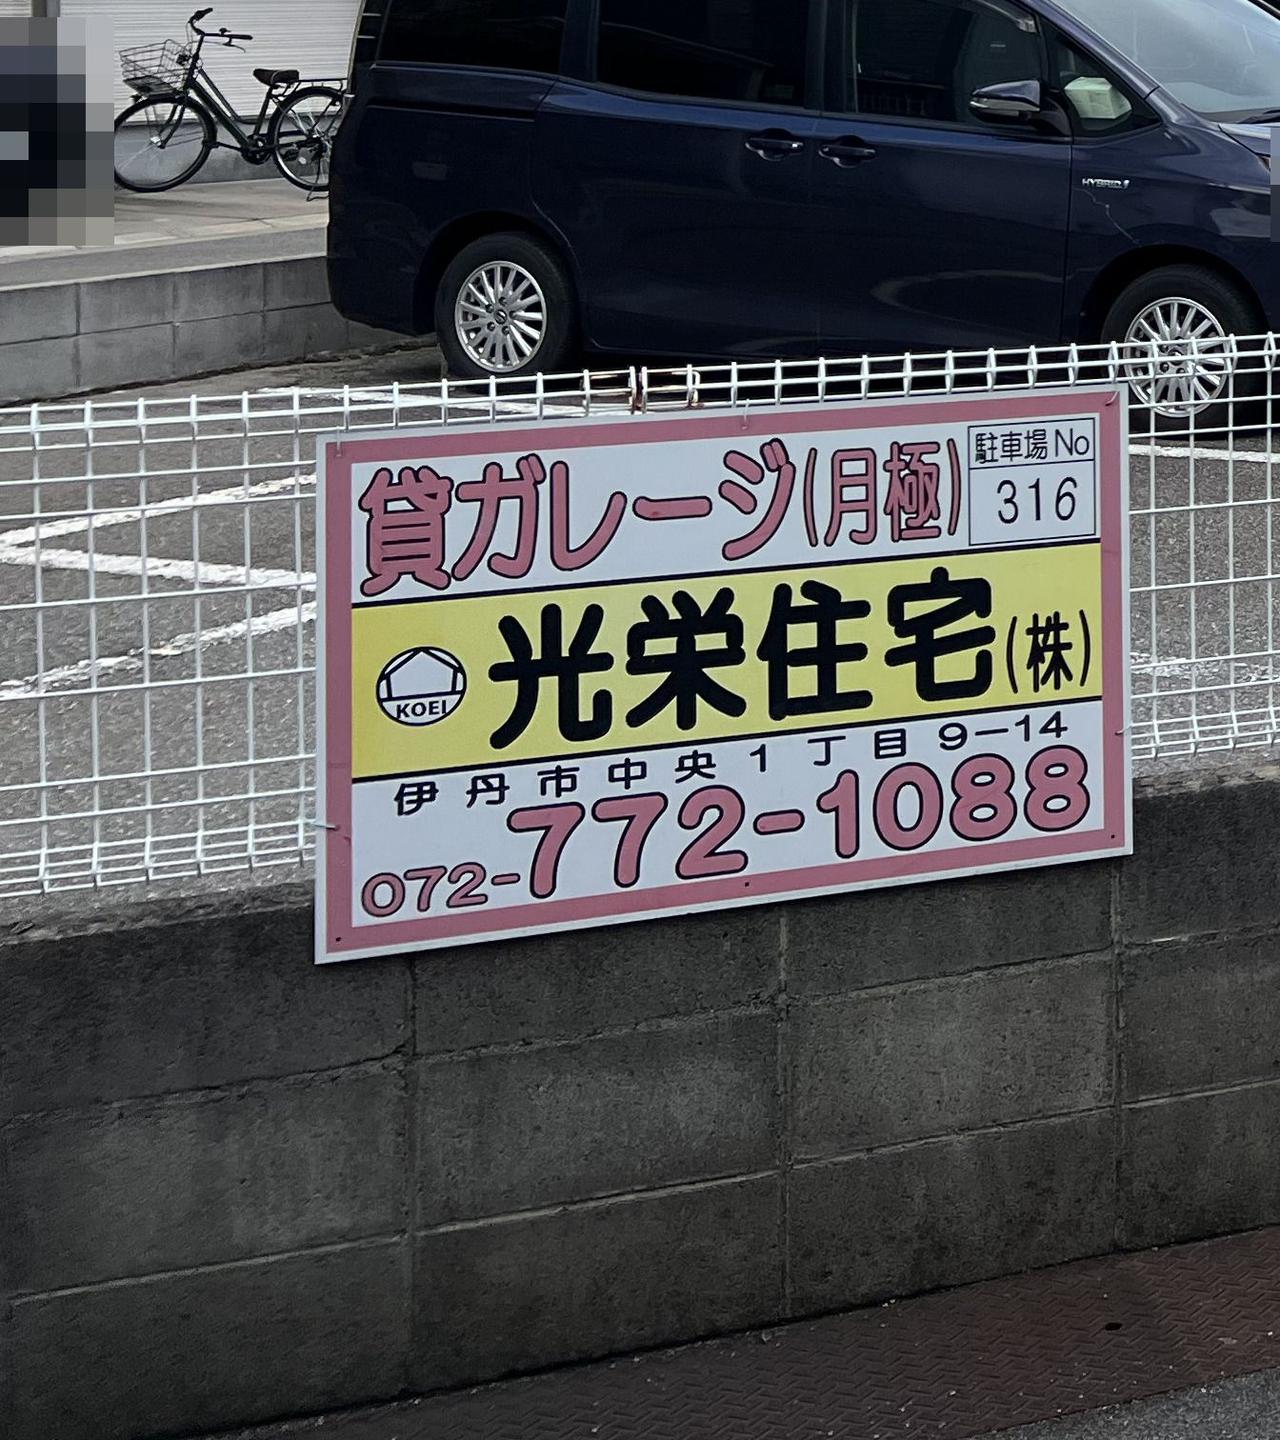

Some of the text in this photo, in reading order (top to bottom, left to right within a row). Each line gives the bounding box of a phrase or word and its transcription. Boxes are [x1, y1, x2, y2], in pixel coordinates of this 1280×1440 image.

[359, 436, 963, 597] 貸ガレージ(月極)
[996, 476, 1080, 525] 316
[395, 697, 448, 719] KOEI
[487, 566, 1093, 751] 光栄住宅(株)
[360, 744, 1092, 919] 072-772-1088
